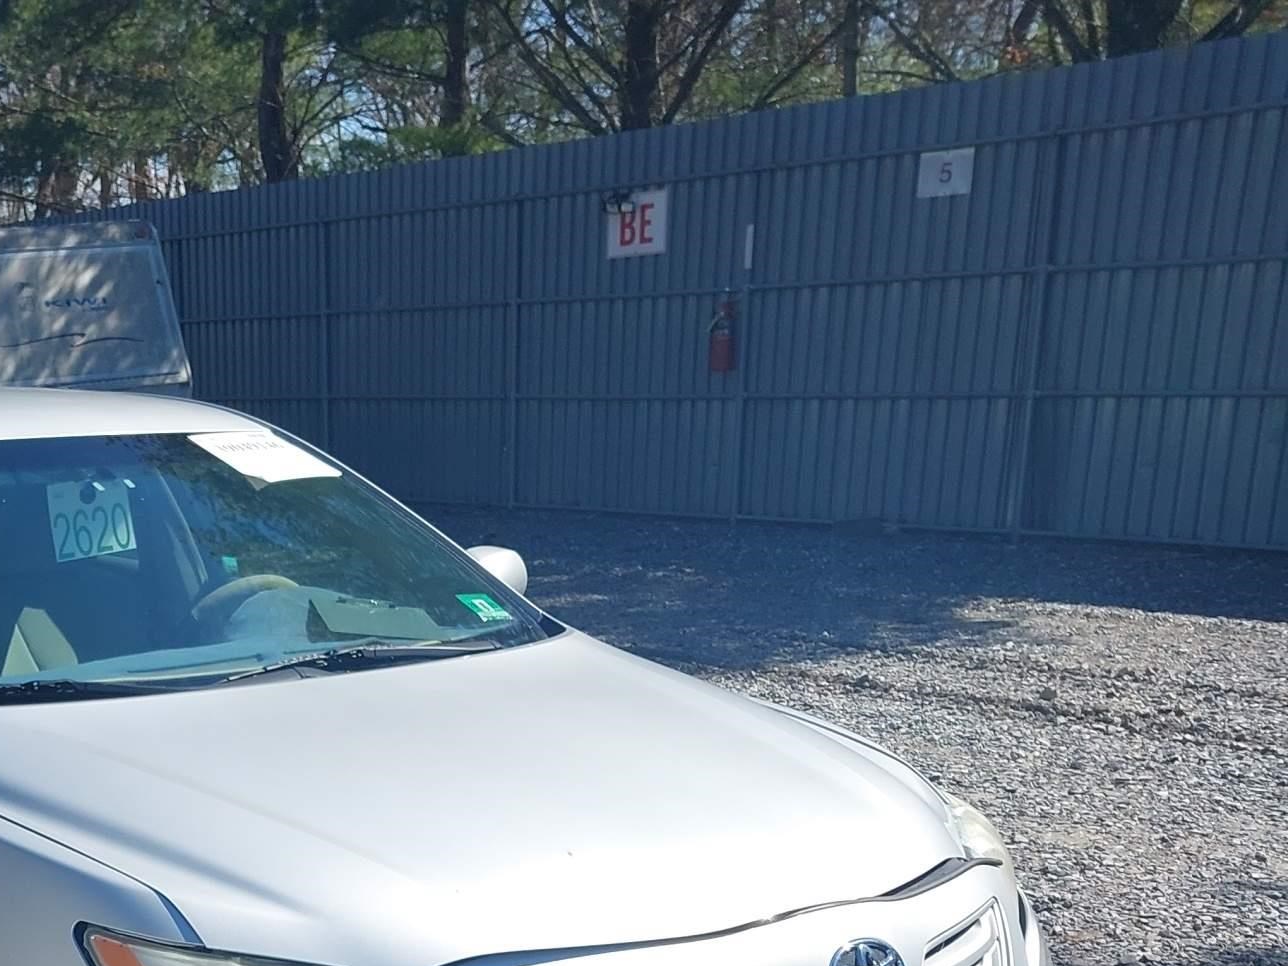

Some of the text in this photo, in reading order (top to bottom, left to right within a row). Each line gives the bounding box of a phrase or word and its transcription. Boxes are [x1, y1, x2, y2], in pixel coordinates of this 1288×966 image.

[939, 162, 953, 184] 5
[619, 202, 655, 247] BE
[53, 502, 131, 561] 2620
